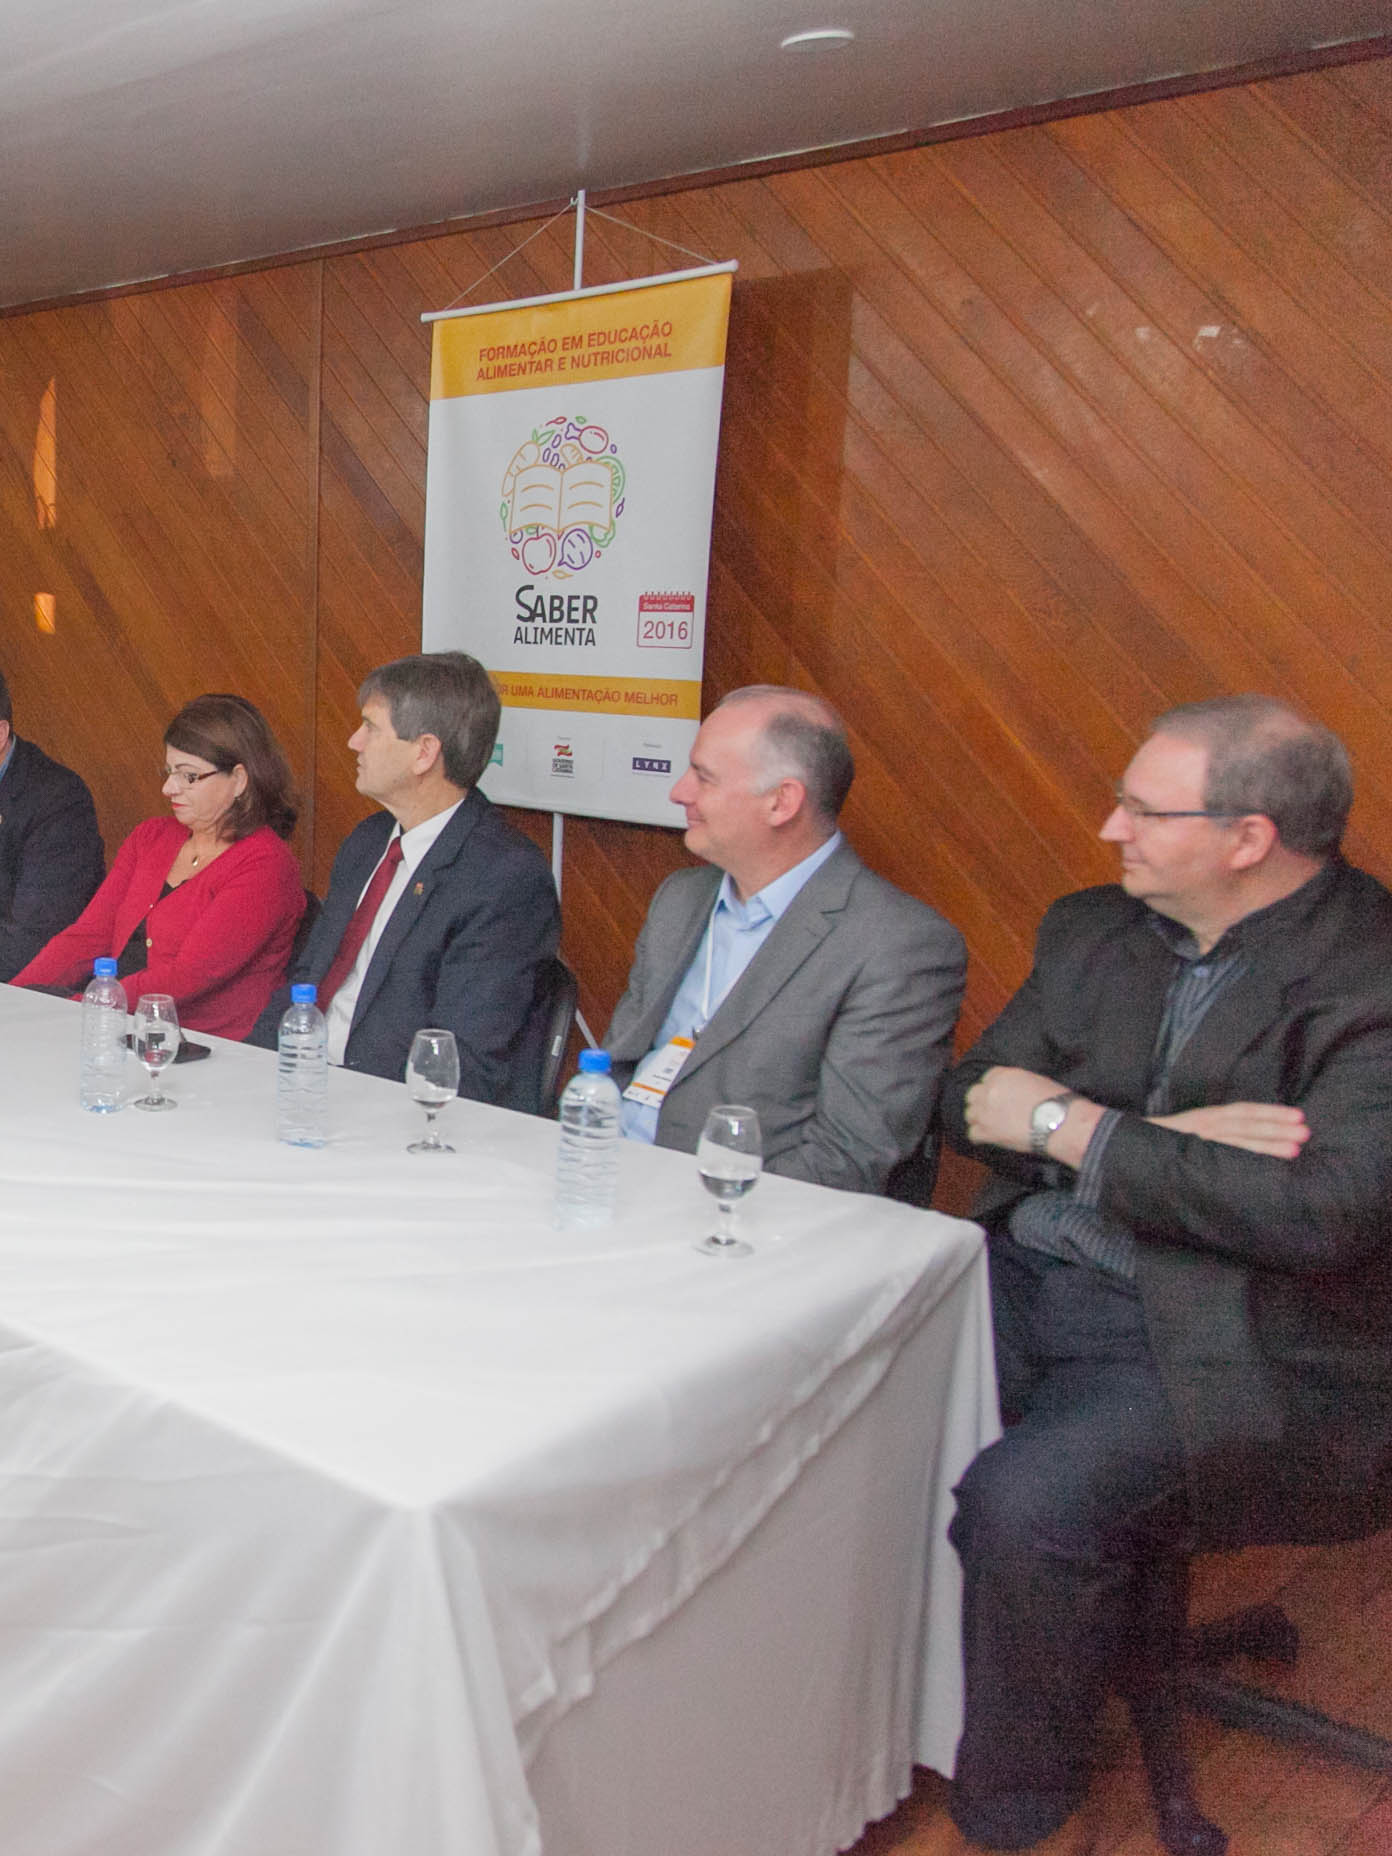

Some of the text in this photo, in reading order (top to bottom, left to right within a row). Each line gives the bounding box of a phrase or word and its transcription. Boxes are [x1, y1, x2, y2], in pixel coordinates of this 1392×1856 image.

[479, 320, 672, 362] FORMAÇÃO EM EDUCAÇÃO
[476, 342, 673, 381] ALIMENTAR E NUTRICIONAL
[513, 626, 596, 646] ALIMENTA
[643, 620, 688, 640] 2016
[510, 685, 534, 697] UMA
[537, 686, 621, 704] ALIMENTAÇÃO
[624, 691, 678, 706] MELHOR
[635, 760, 668, 771] LYNX
